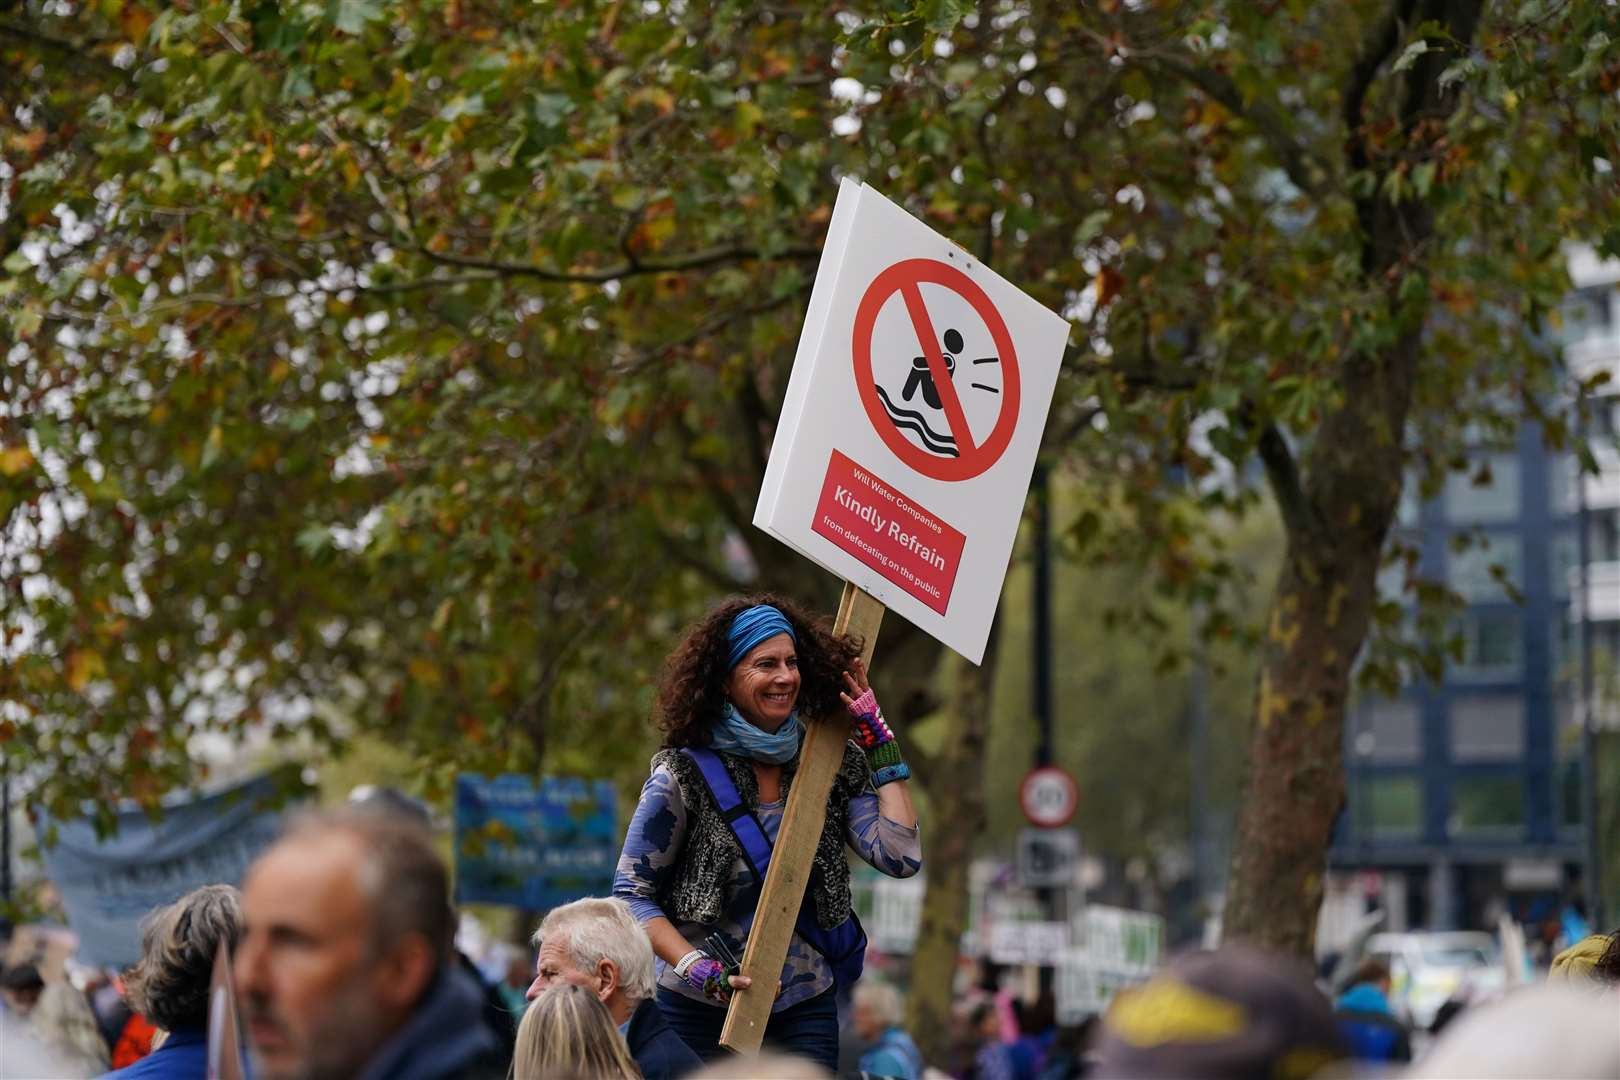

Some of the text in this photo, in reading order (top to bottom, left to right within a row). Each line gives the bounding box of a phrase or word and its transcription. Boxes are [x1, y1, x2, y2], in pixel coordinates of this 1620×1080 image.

[834, 485, 945, 571] Kindly Refrain
[853, 468, 943, 534] Will Water Companies
[823, 515, 941, 599] from defecating on the public
